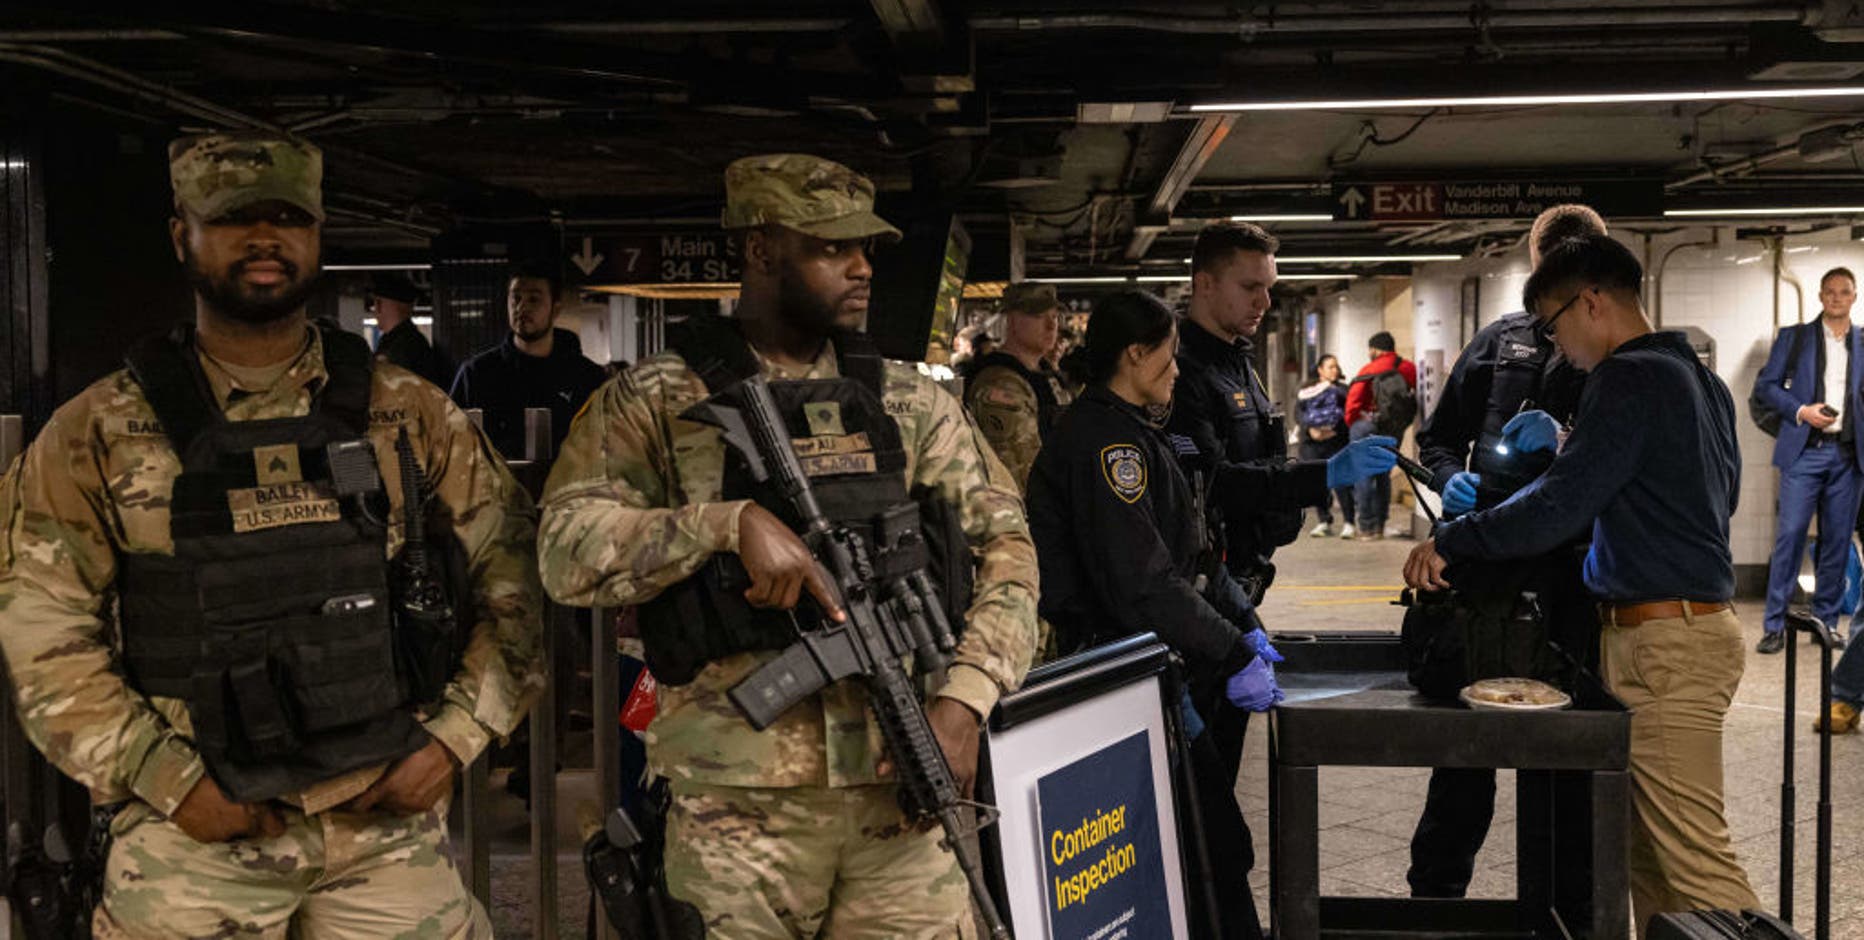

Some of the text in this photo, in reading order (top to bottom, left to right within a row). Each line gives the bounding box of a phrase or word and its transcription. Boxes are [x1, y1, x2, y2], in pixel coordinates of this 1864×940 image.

[1373, 185, 1436, 213] Exit
[1444, 184, 1583, 199] Vanderbilt Avenue
[1444, 200, 1510, 215] Madison
[660, 235, 738, 257] Main S
[624, 248, 642, 272] 7
[660, 258, 693, 282] 34
[127, 419, 168, 434] BAIL
[1107, 448, 1142, 465] POLICE
[255, 484, 310, 504] BAILEY
[283, 503, 329, 521] ARMY
[1051, 804, 1126, 866] Container
[1055, 842, 1136, 911] Inspection
